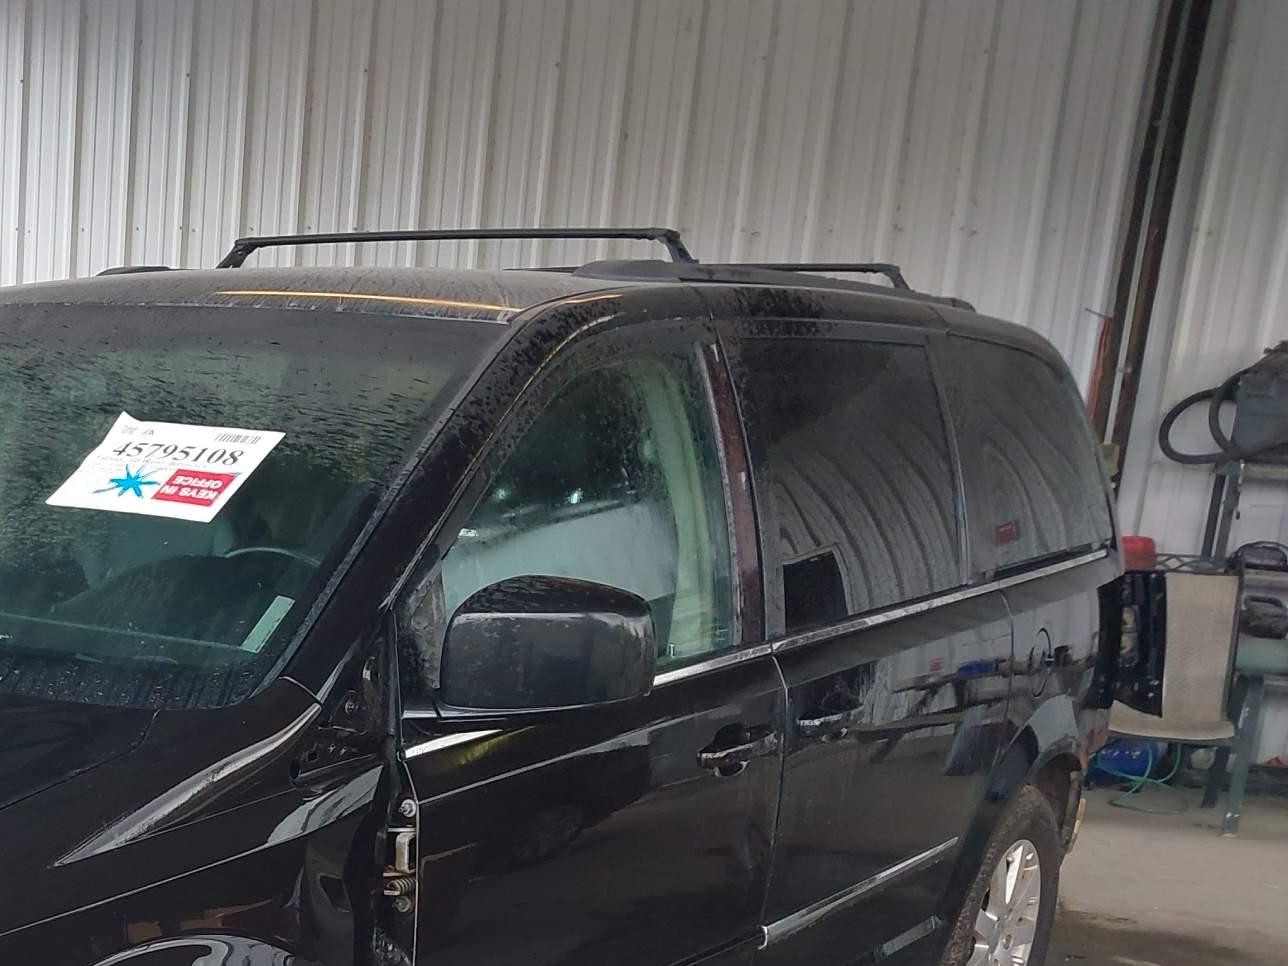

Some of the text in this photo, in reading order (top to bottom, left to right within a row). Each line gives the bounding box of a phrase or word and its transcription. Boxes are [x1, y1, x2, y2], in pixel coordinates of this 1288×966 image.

[112, 440, 245, 466] 45795108
[172, 475, 224, 489] OFFICE
[159, 484, 219, 500] KEYS IN
